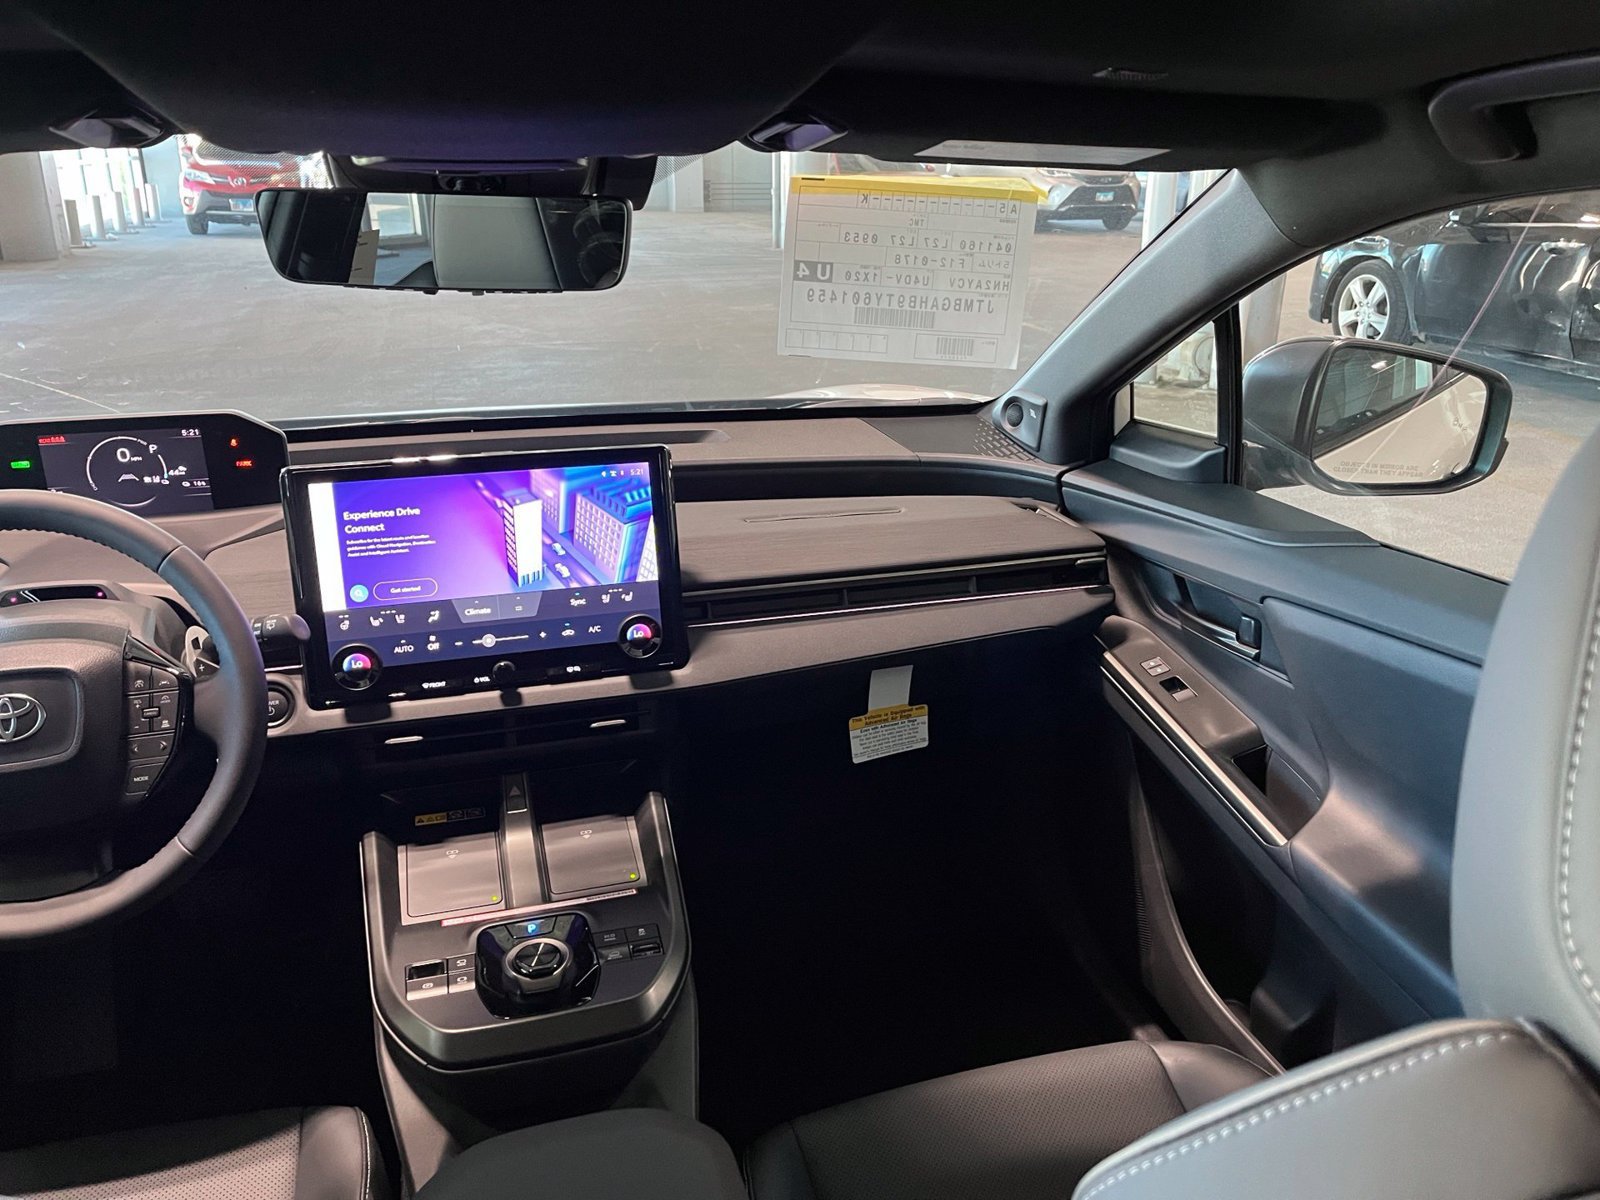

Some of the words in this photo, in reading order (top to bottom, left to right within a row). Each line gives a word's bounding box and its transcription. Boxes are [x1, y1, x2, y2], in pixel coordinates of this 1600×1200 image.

[181, 429, 199, 437] 5:21
[148, 444, 158, 454] P
[343, 509, 395, 522] Experience
[396, 507, 421, 517] Drive
[344, 523, 385, 534] Connect
[401, 585, 422, 593] started
[569, 598, 587, 607] Sync
[464, 607, 492, 616] Climate
[588, 625, 602, 634] A/C
[393, 645, 414, 654] AUTO
[427, 642, 440, 651] Off
[527, 924, 537, 934] P
